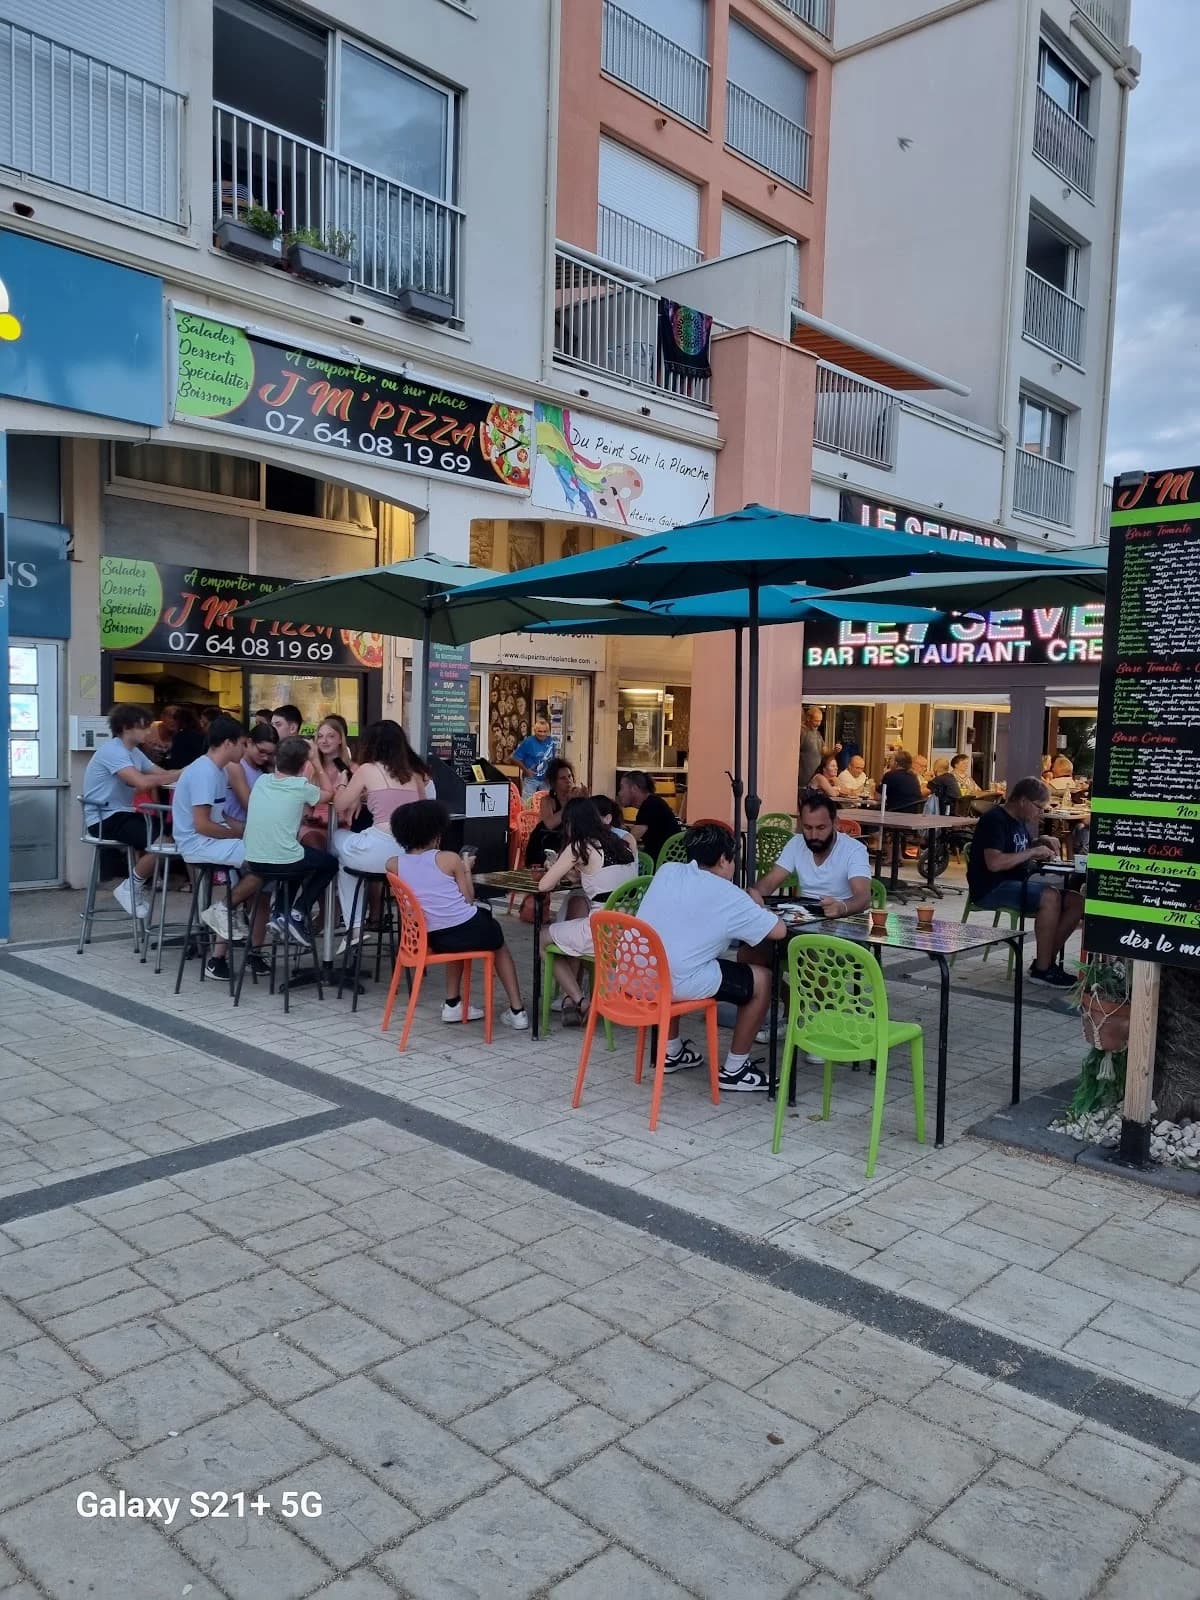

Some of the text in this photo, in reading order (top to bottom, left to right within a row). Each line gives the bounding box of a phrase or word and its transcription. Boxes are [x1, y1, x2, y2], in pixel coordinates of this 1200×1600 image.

[177, 315, 235, 346] Salades
[178, 339, 235, 367] Desserts
[178, 381, 233, 407] Boissons
[307, 360, 376, 384] emporter
[381, 378, 399, 392] ou
[403, 384, 426, 397] sur
[429, 391, 468, 410] place
[265, 410, 471, 473] 07 64 08 19 69
[572, 428, 710, 481] Du Peint Sur la Planche
[630, 509, 655, 523] Atelier
[1125, 522, 1192, 541] Base Tomate
[102, 559, 147, 578] Salades
[102, 579, 147, 598] Desserts
[200, 574, 256, 595] emporter
[259, 581, 274, 593] ou
[102, 618, 144, 636] Boissons
[168, 631, 333, 661] 07 64 08 19 69
[807, 646, 853, 666] BAR
[863, 640, 1031, 666] RESTAURANT
[1116, 661, 1142, 674] Base
[1146, 661, 1181, 673] Tomate
[1112, 731, 1178, 744] Base Crème
[1176, 805, 1198, 818] Nos
[1096, 840, 1115, 852] Tarif
[1118, 858, 1197, 877] Nos desserts
[1142, 895, 1161, 907] Tarif
[1120, 929, 1152, 949] dès
[1156, 933, 1175, 953] le
